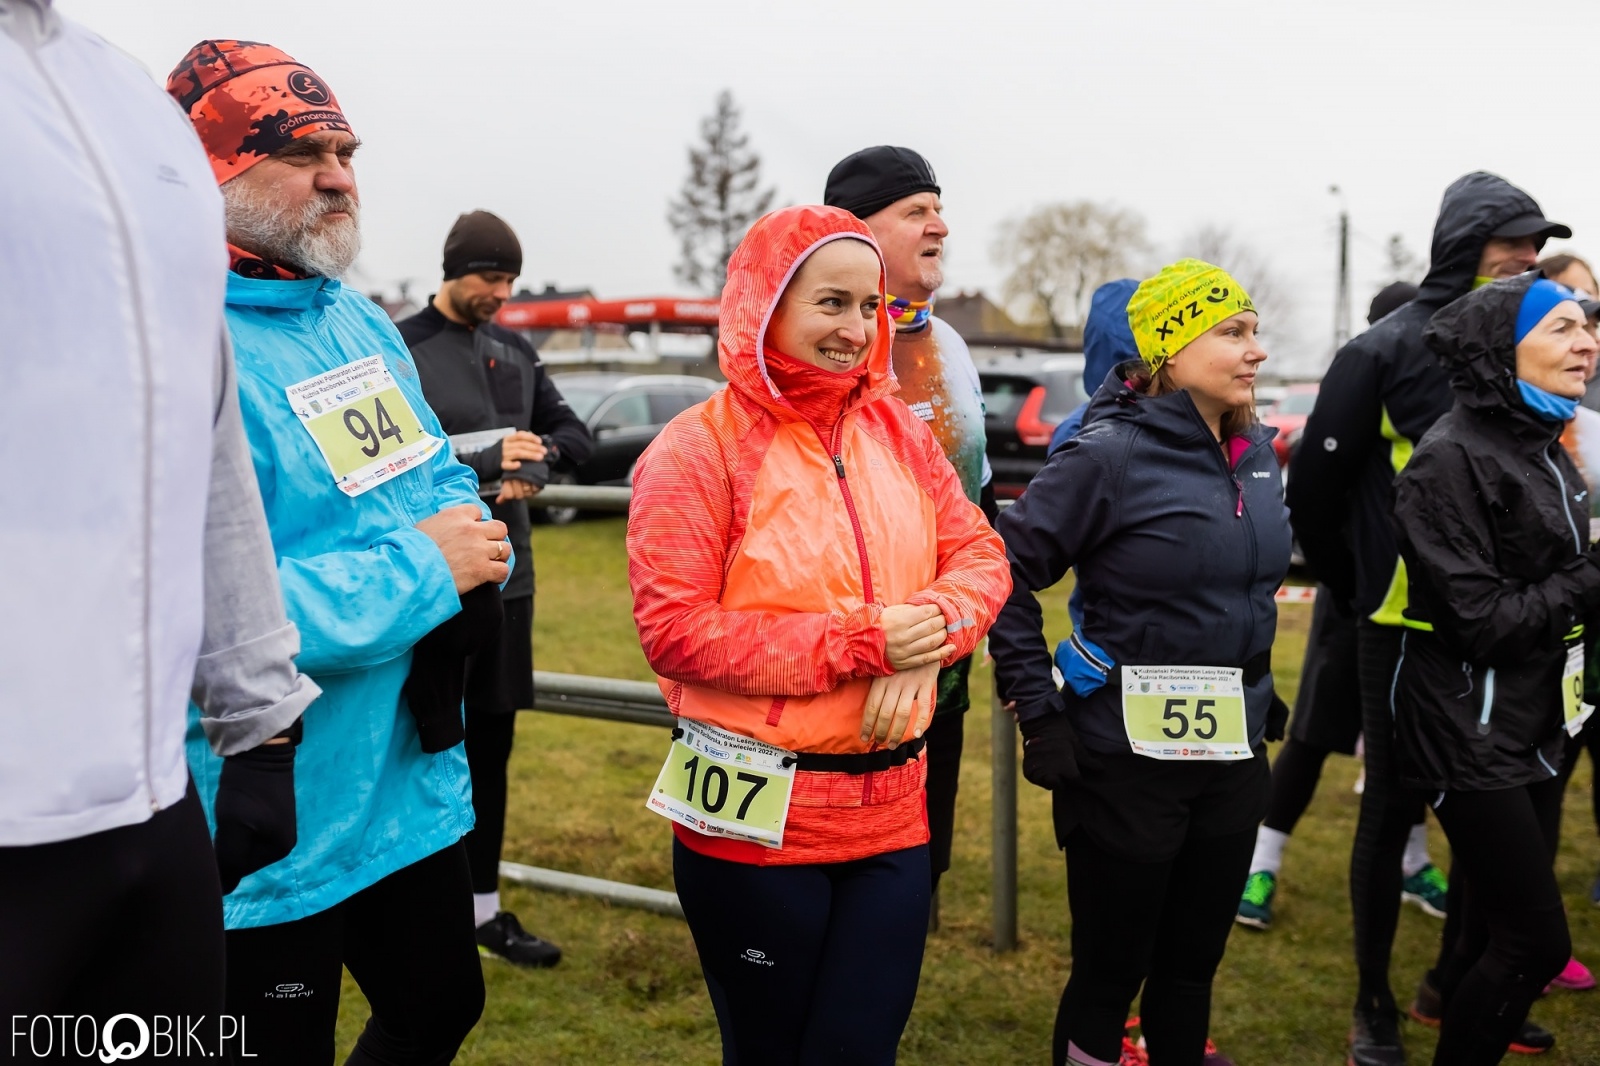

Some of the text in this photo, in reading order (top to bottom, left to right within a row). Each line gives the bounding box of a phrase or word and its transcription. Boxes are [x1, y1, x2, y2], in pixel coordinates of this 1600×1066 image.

[1152, 277, 1220, 322] fabryka aktywności
[1155, 301, 1203, 341] XYZ
[343, 397, 403, 458] 94
[1162, 698, 1217, 740] 55
[729, 742, 757, 753] kwiecień
[758, 748, 773, 756] 2022
[736, 736, 756, 747] Leśny
[684, 755, 768, 821] 107
[740, 953, 775, 967] Kalenji
[265, 989, 314, 999] Kalenji
